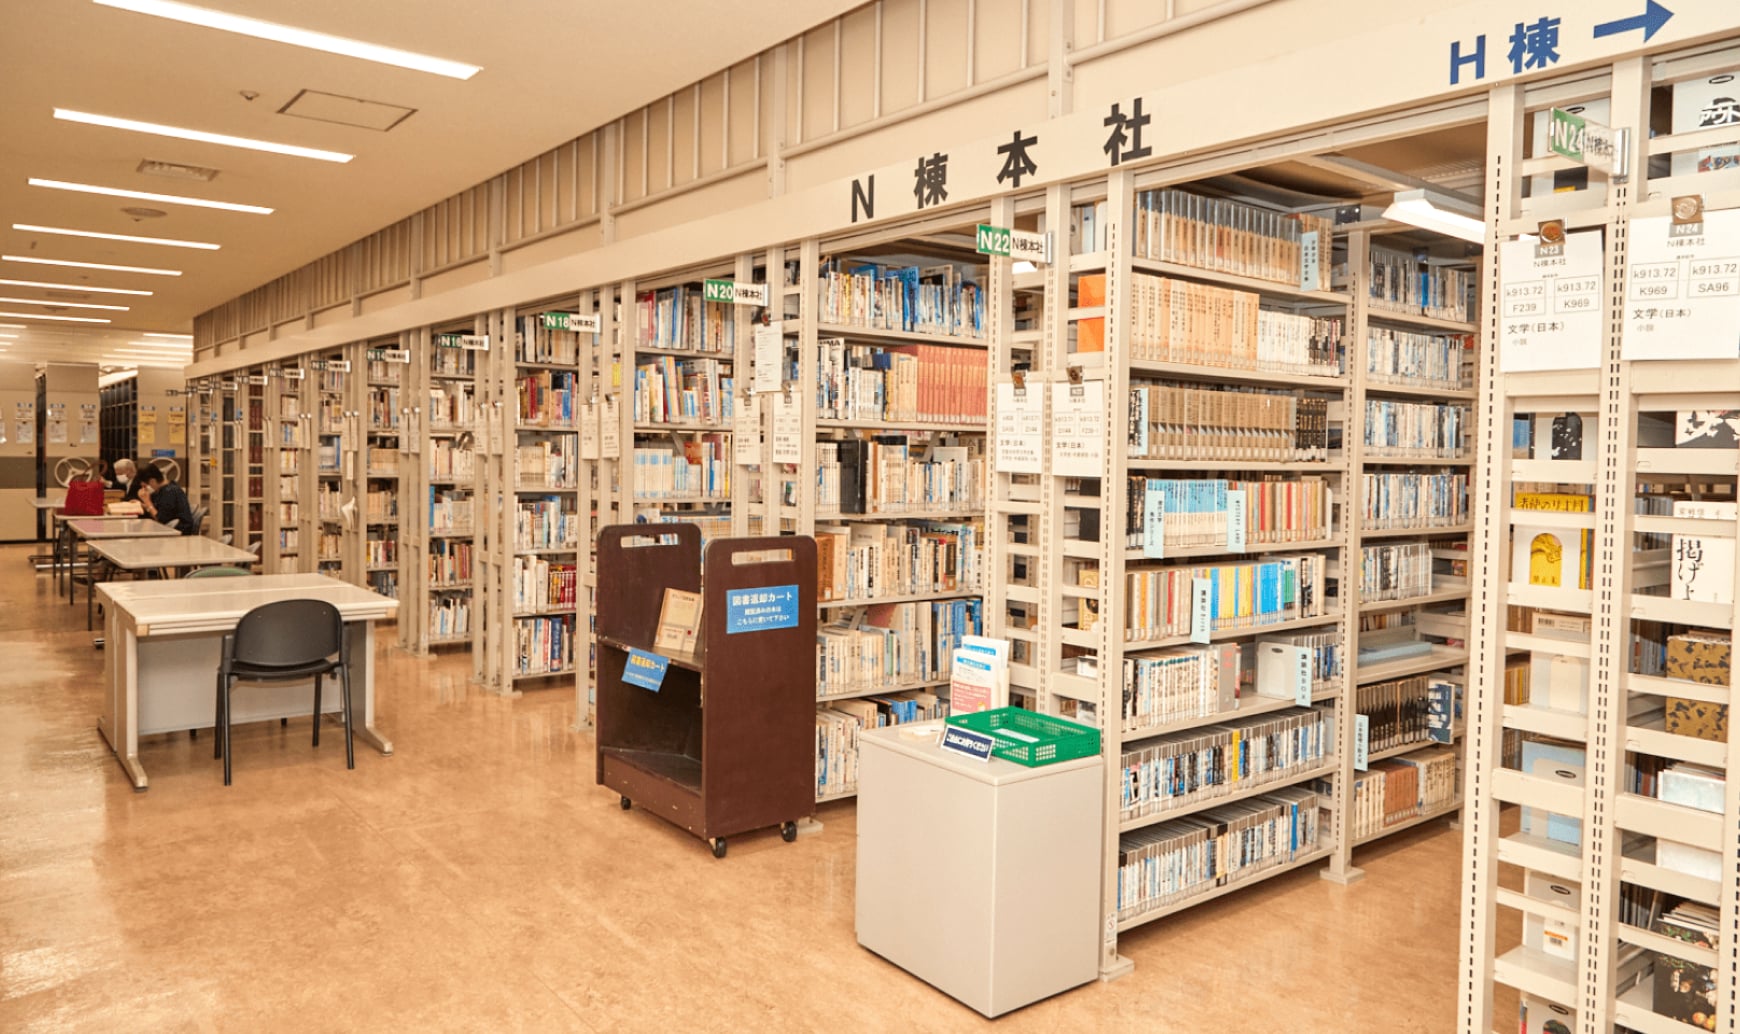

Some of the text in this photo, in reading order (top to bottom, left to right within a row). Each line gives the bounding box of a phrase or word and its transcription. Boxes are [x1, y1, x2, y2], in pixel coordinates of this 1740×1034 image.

[1449, 15, 1562, 86] H棟
[1554, 117, 1584, 155] N24
[850, 96, 1153, 223] N棟本社
[980, 229, 1045, 254] N22 N棟本社
[1632, 267, 1677, 279] k913.72
[1692, 263, 1737, 276] k913.72
[706, 283, 734, 300] N20
[1506, 285, 1544, 297] k913.72
[1556, 280, 1597, 293] k913.72
[1639, 285, 1669, 297] K969
[1697, 281, 1731, 294] SA96
[1512, 302, 1538, 313] F239
[1564, 297, 1591, 309] K969
[546, 314, 569, 328] N18
